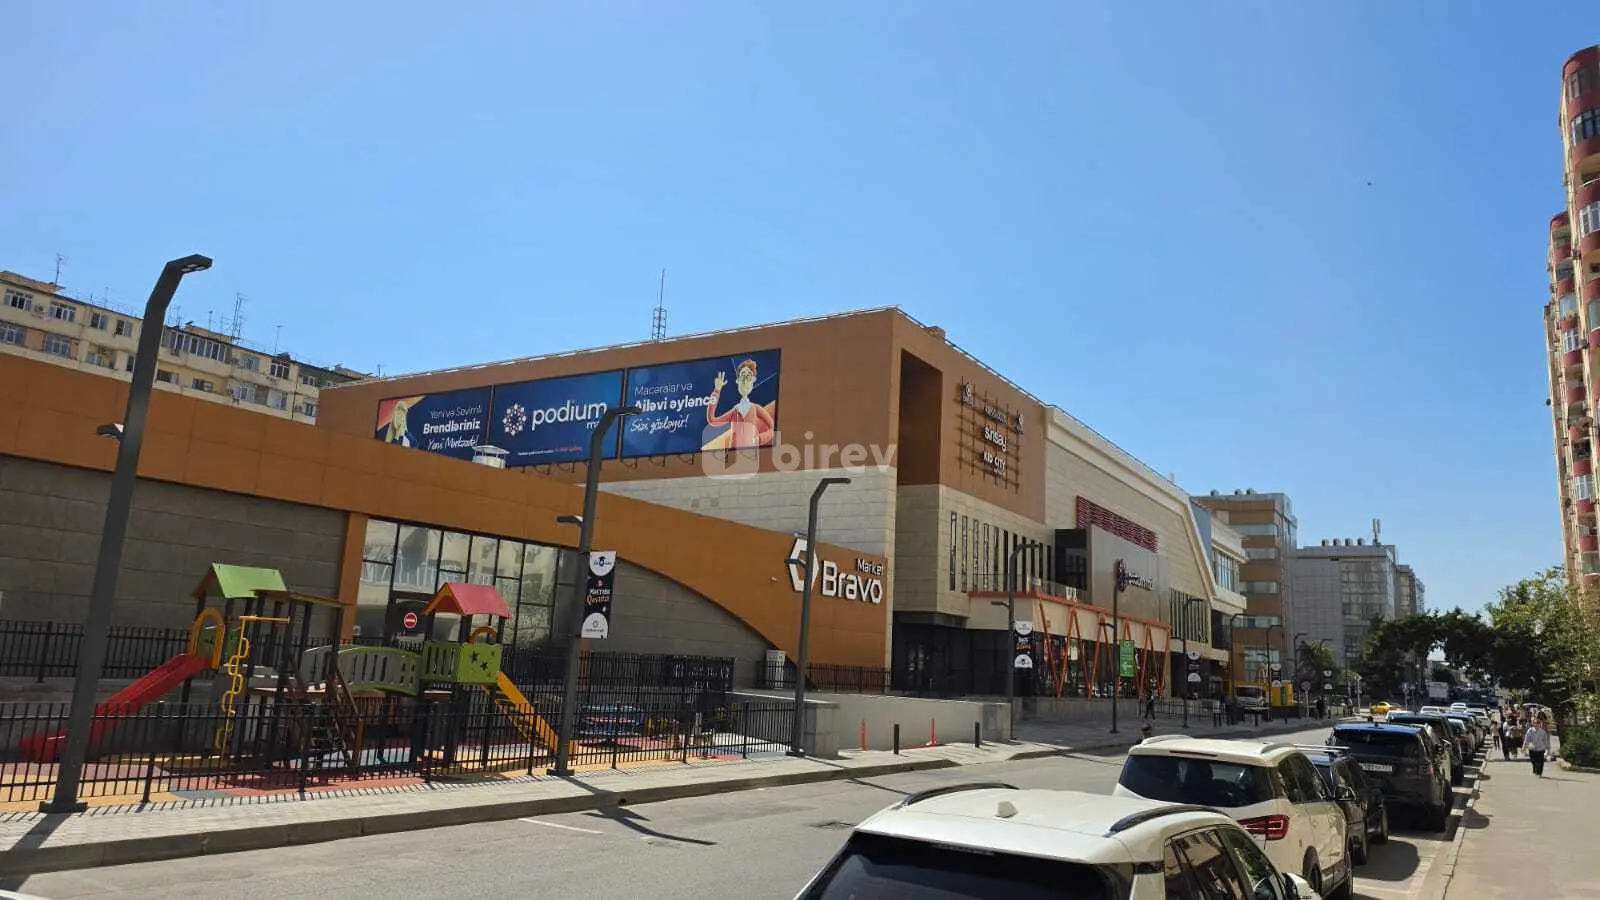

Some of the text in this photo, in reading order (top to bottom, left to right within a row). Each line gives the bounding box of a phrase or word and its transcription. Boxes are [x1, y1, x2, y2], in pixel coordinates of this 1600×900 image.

[423, 418, 481, 434] Brendləriniz
[531, 399, 607, 432] podium
[857, 558, 884, 576] Market
[822, 560, 884, 604] Bravo
